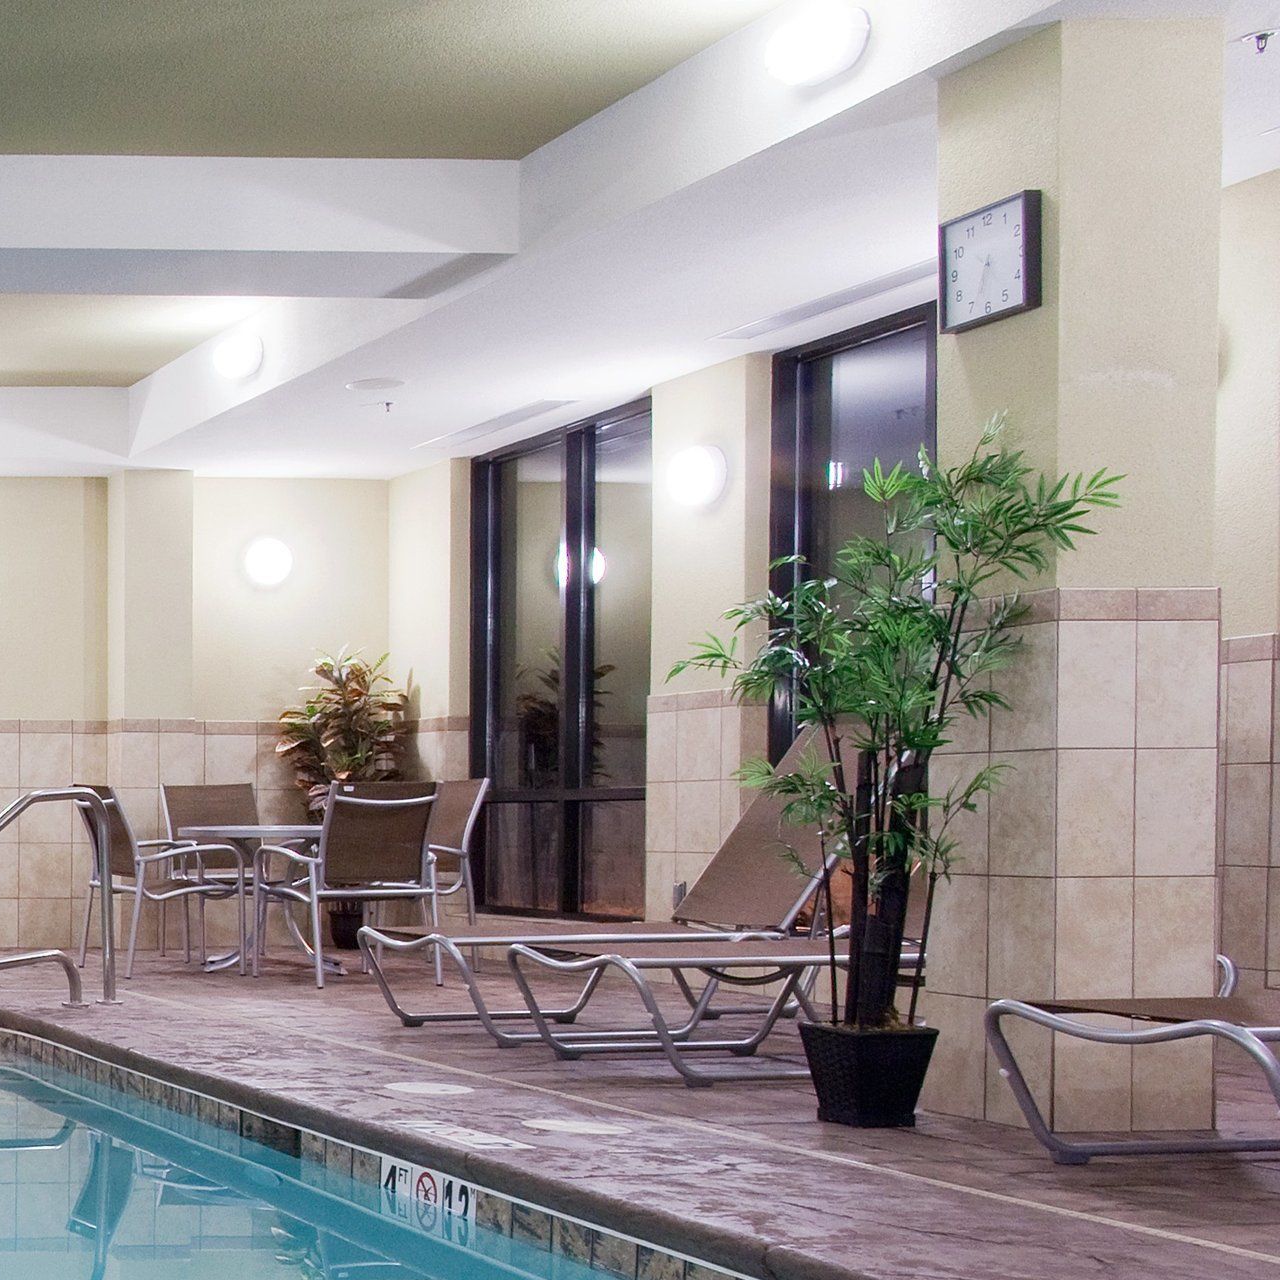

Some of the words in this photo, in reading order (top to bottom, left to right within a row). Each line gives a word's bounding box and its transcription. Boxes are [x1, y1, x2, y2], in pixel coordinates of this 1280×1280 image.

[982, 213, 992, 226] 12
[966, 226, 975, 239] 11
[1014, 224, 1020, 237] 2
[954, 246, 964, 259] 10
[951, 270, 958, 282] 9
[1014, 269, 1020, 280] 4
[956, 290, 963, 302] 8
[1002, 289, 1009, 302] 5
[968, 302, 975, 313] 7
[984, 302, 992, 314] 6
[399, 1167, 408, 1184] FT
